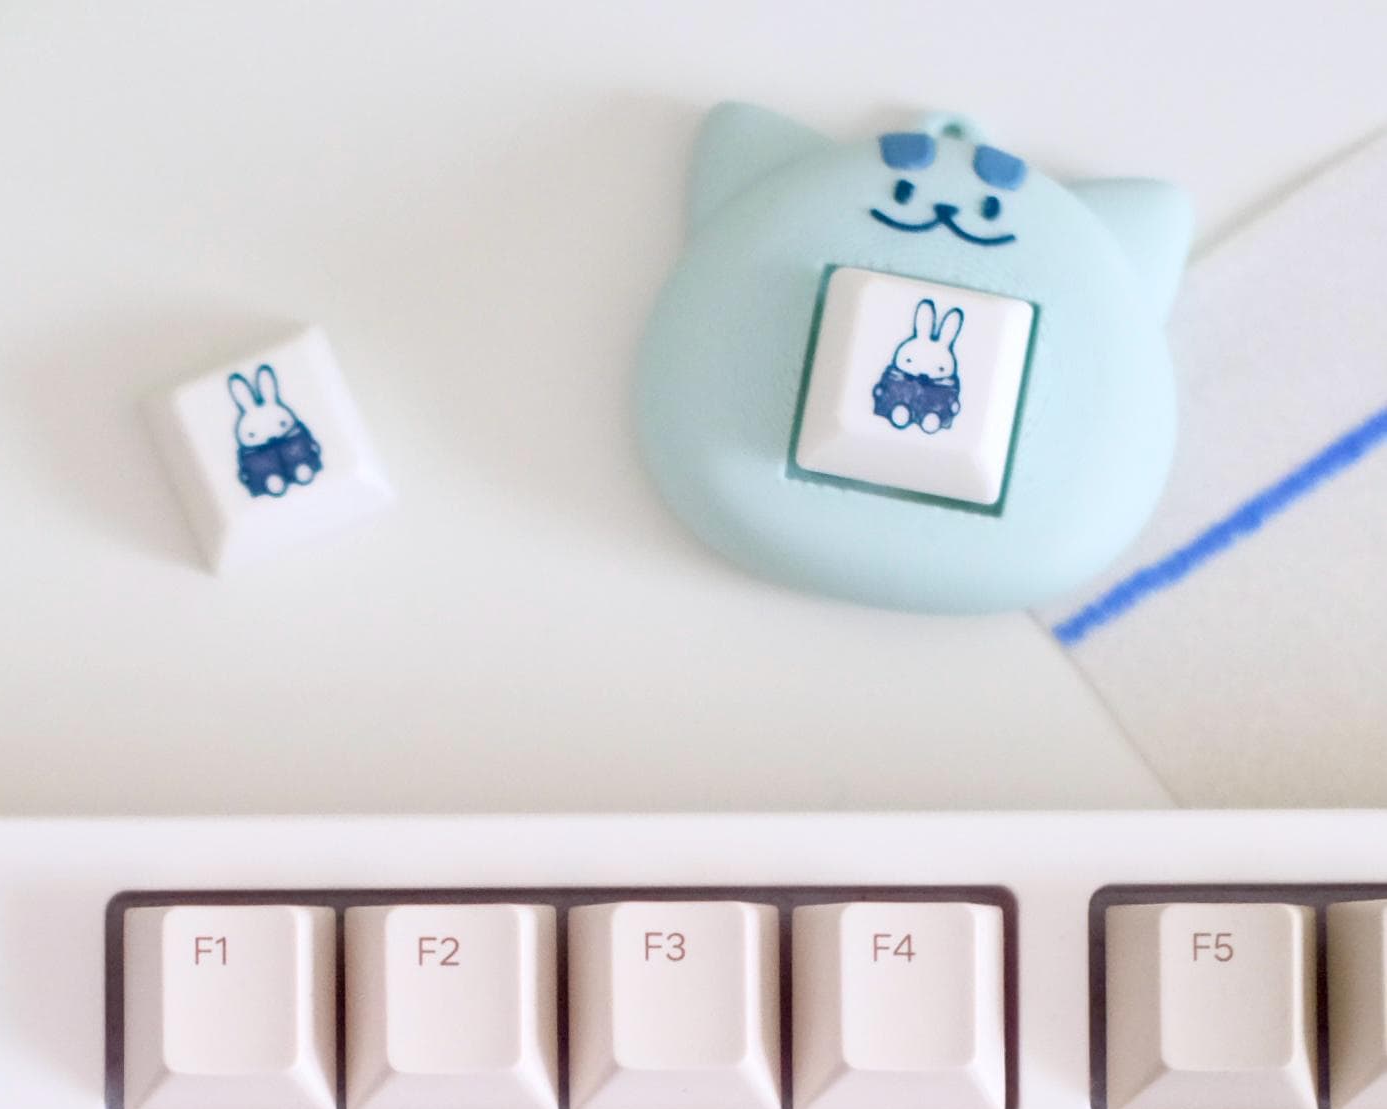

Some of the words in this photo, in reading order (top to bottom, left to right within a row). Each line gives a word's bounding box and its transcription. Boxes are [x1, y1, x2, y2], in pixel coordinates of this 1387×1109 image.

[194, 936, 227, 966] F1
[418, 936, 460, 967] F2
[644, 931, 687, 963] F3
[873, 933, 916, 963] F4
[1192, 932, 1235, 963] F5
